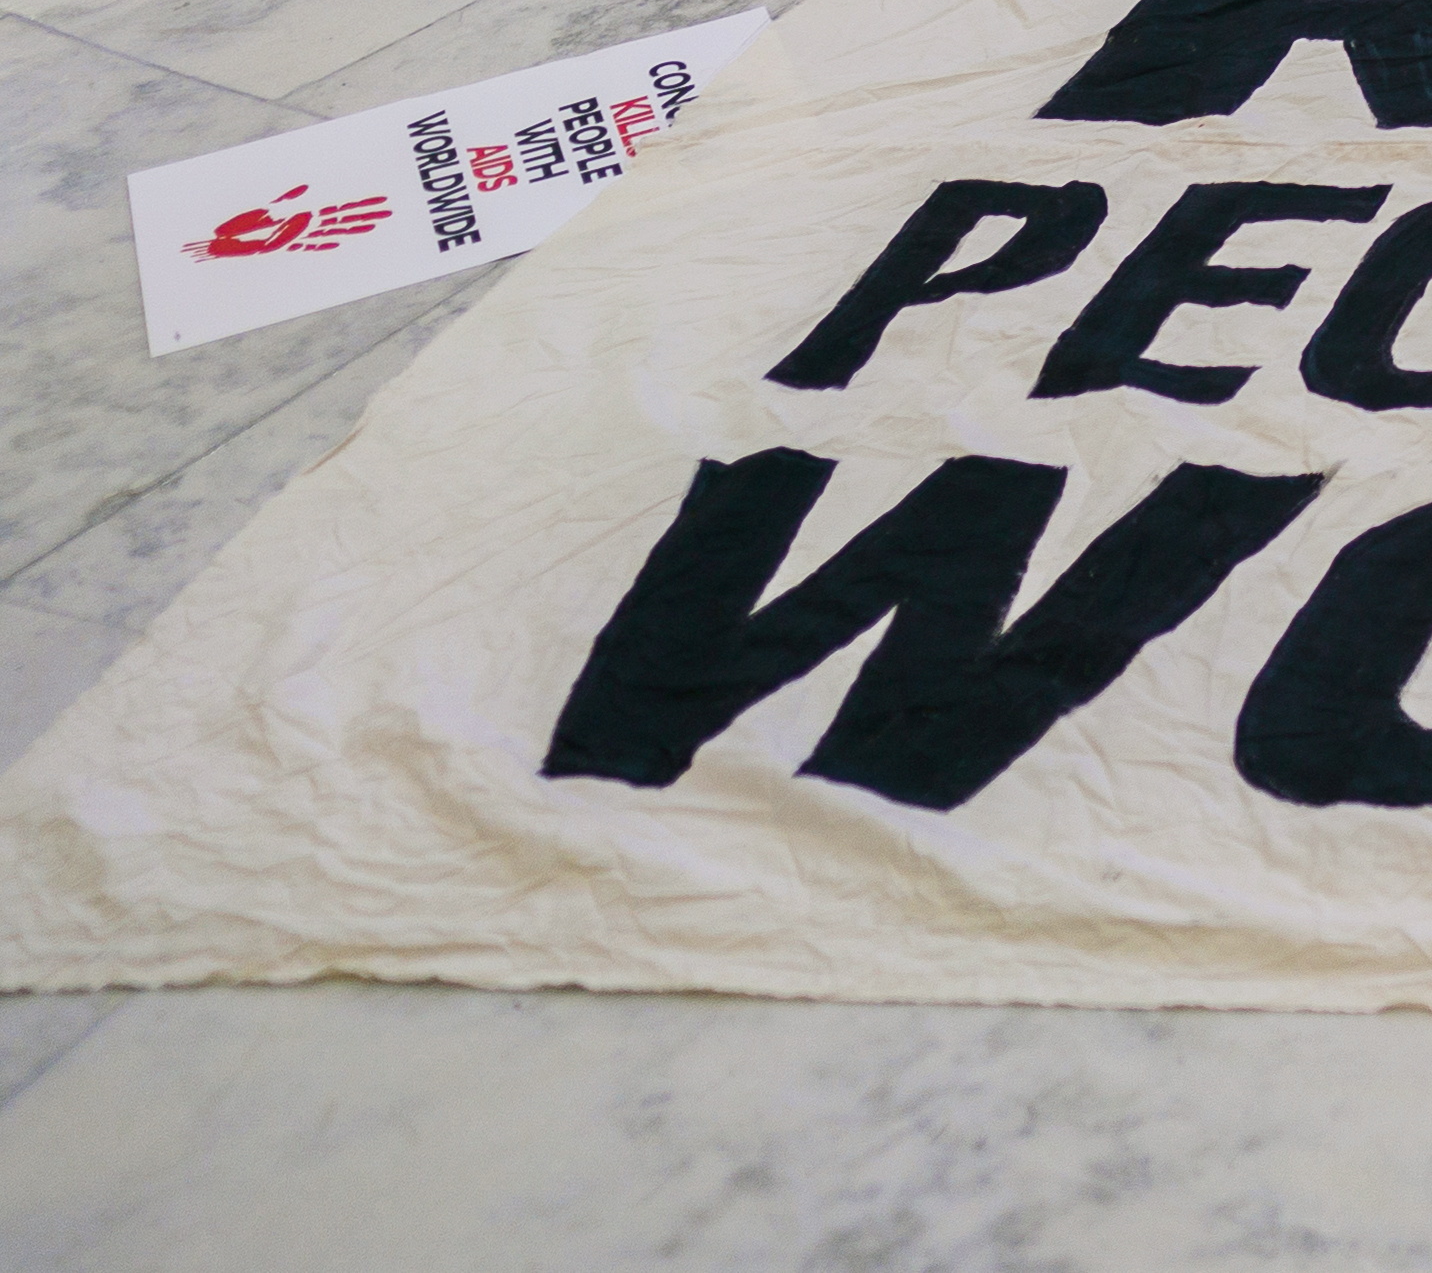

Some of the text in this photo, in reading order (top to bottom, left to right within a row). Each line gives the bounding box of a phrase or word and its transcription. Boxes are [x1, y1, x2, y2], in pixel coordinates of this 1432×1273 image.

[465, 144, 519, 193] AIDS
[513, 119, 570, 184] WITH
[557, 96, 626, 186] PEOPLE
[406, 109, 484, 255] WORLDWIDE
